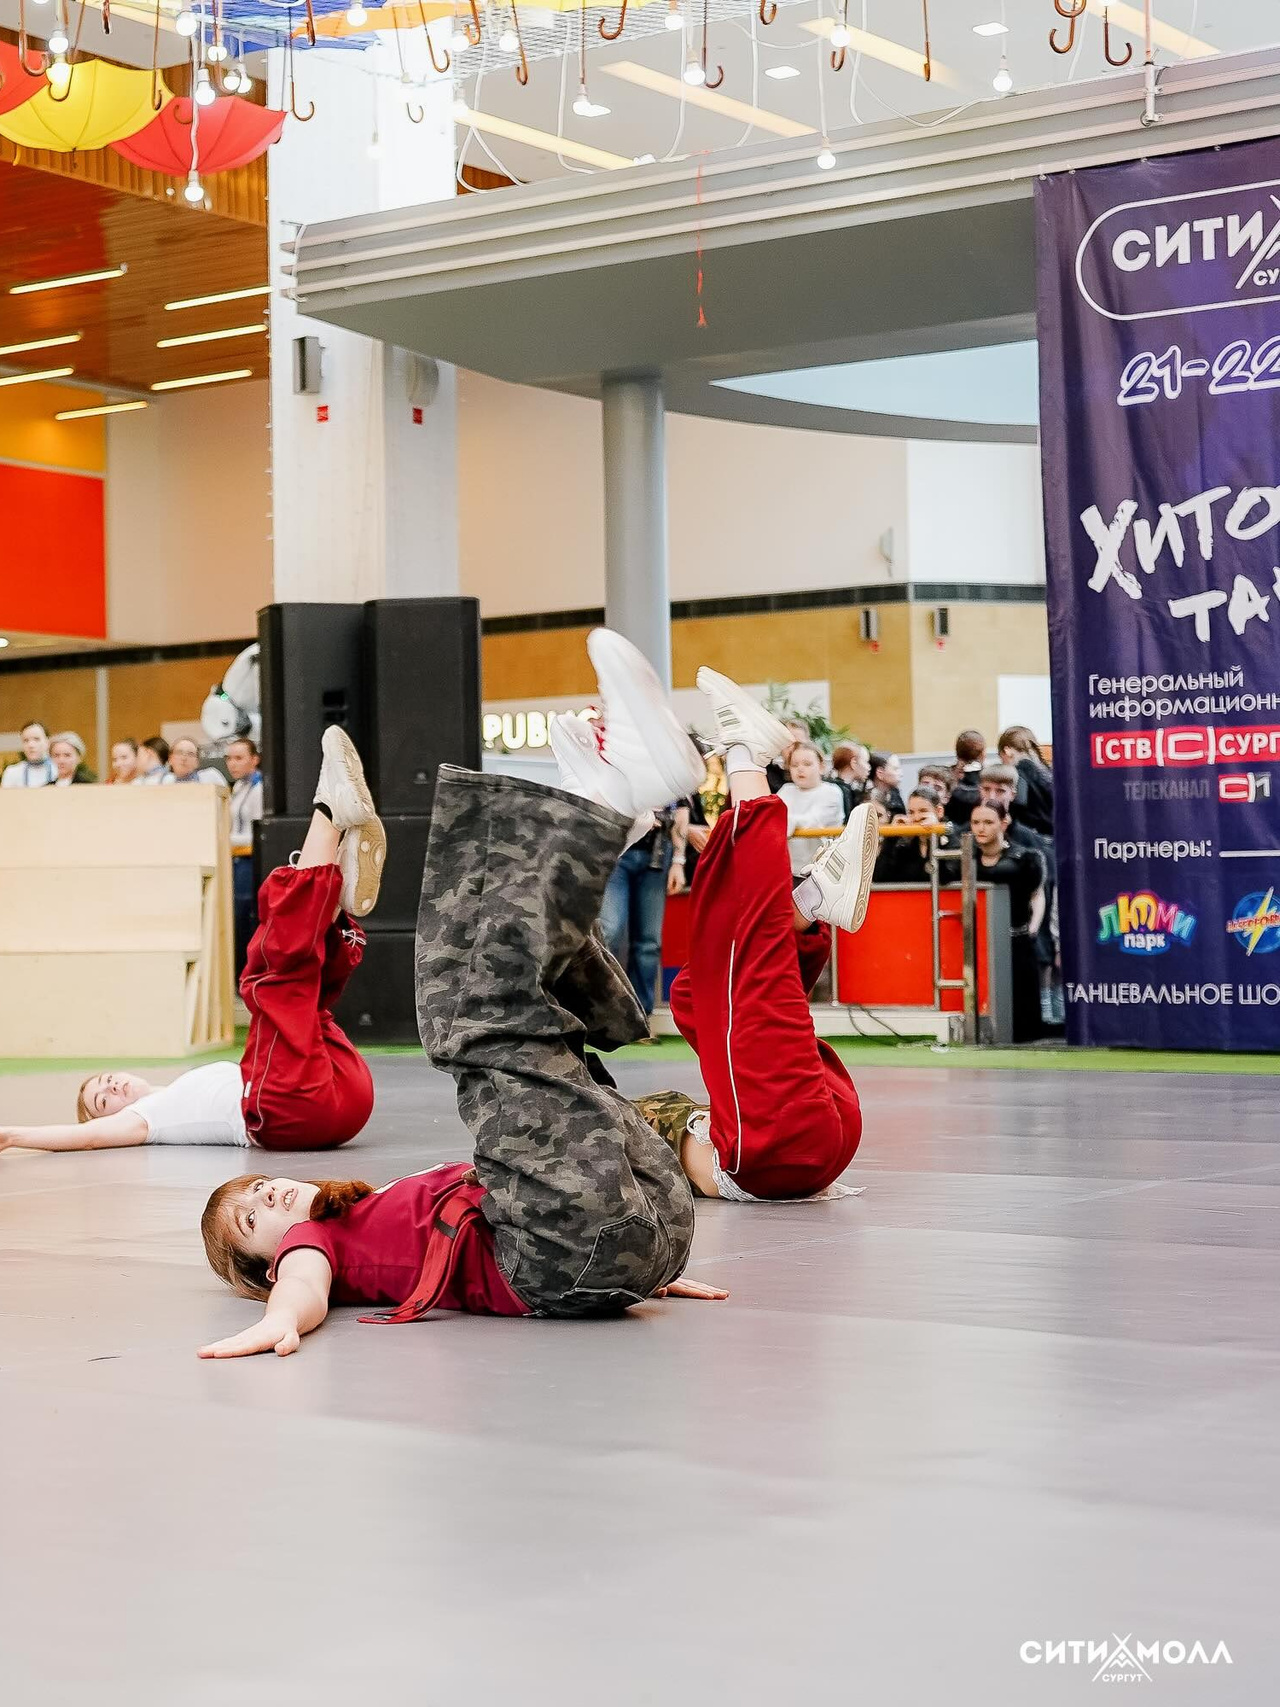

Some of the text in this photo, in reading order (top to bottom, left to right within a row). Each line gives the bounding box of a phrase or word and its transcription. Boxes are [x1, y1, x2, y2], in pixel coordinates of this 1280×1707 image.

[1111, 209, 1263, 272] СИТИ
[1117, 335, 1280, 406] 21-22
[1088, 664, 1244, 697] Генеральный
[1123, 778, 1210, 801] ТЕЛЕКАНАЛ
[1094, 837, 1212, 863] Партнеры:
[1123, 933, 1166, 952] парк
[1065, 982, 1233, 1006] ТАНЦЕВАЛЬНОЕ
